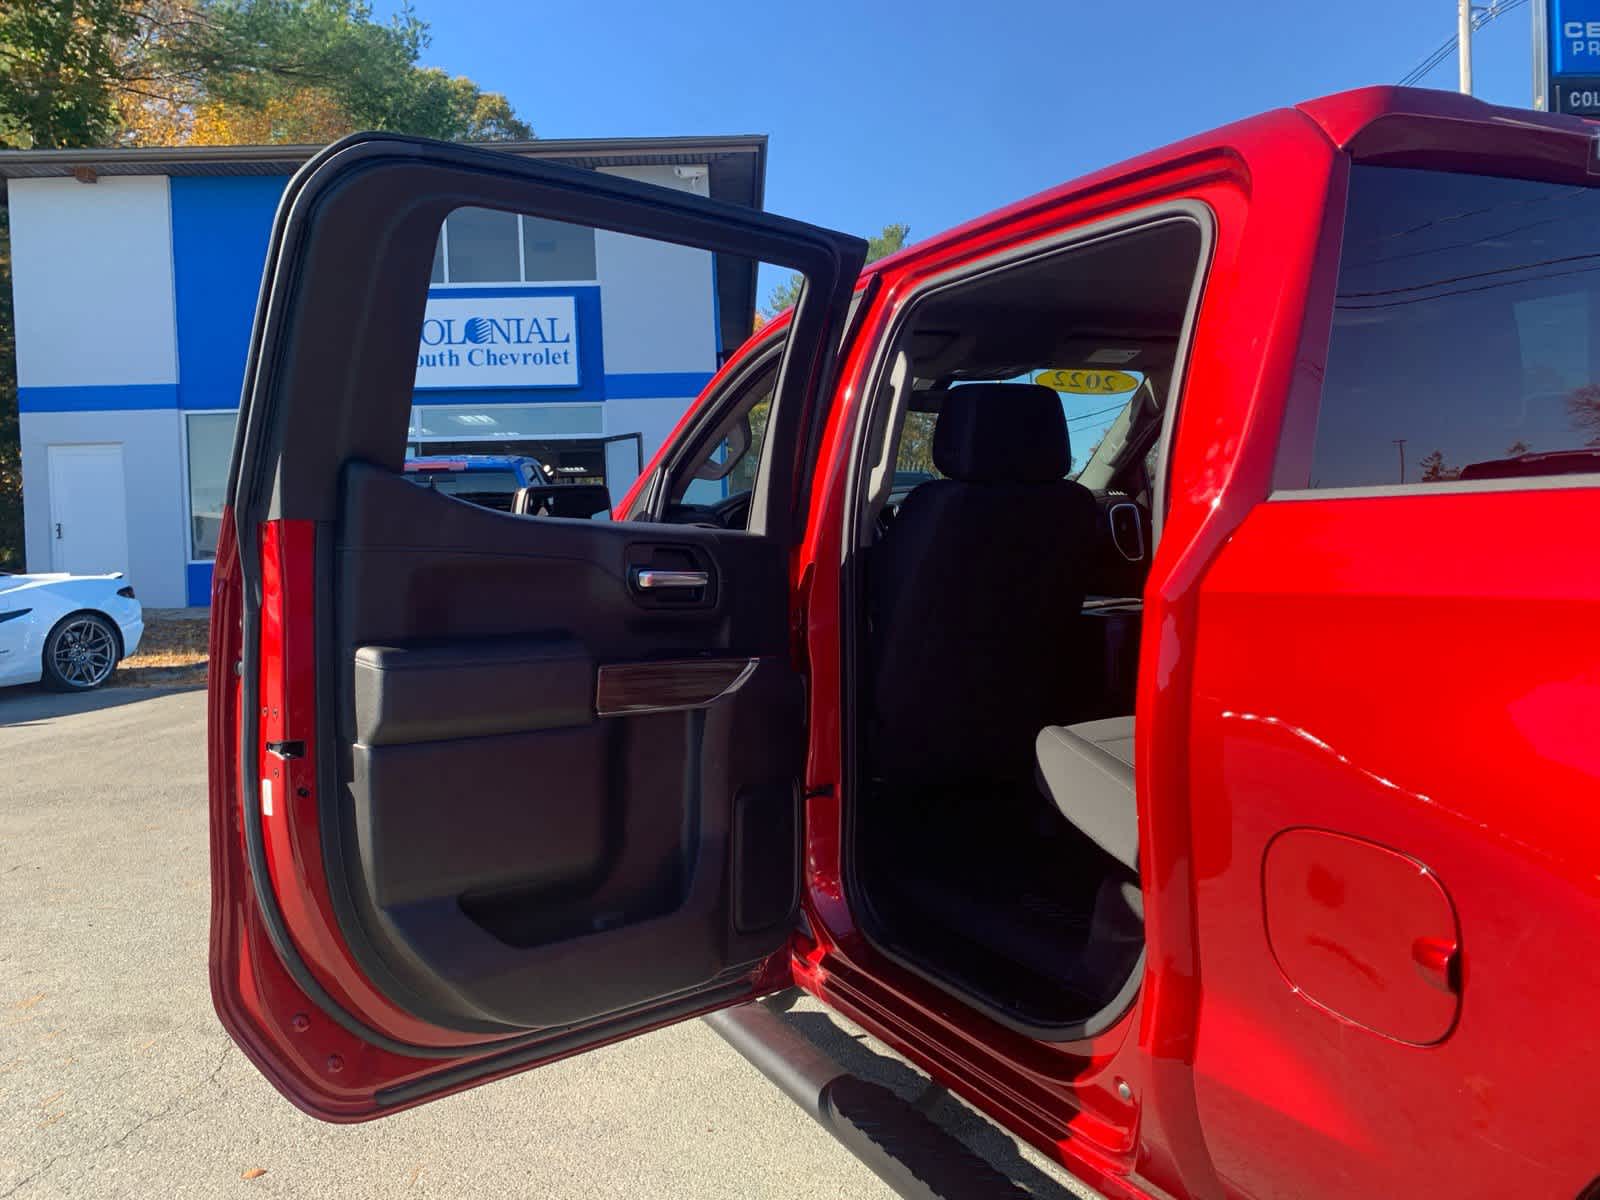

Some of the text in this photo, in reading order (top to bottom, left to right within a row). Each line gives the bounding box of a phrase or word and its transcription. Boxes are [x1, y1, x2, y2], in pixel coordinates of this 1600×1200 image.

[421, 317, 570, 346] OLONIAL
[418, 348, 570, 367] outh Chevrolet
